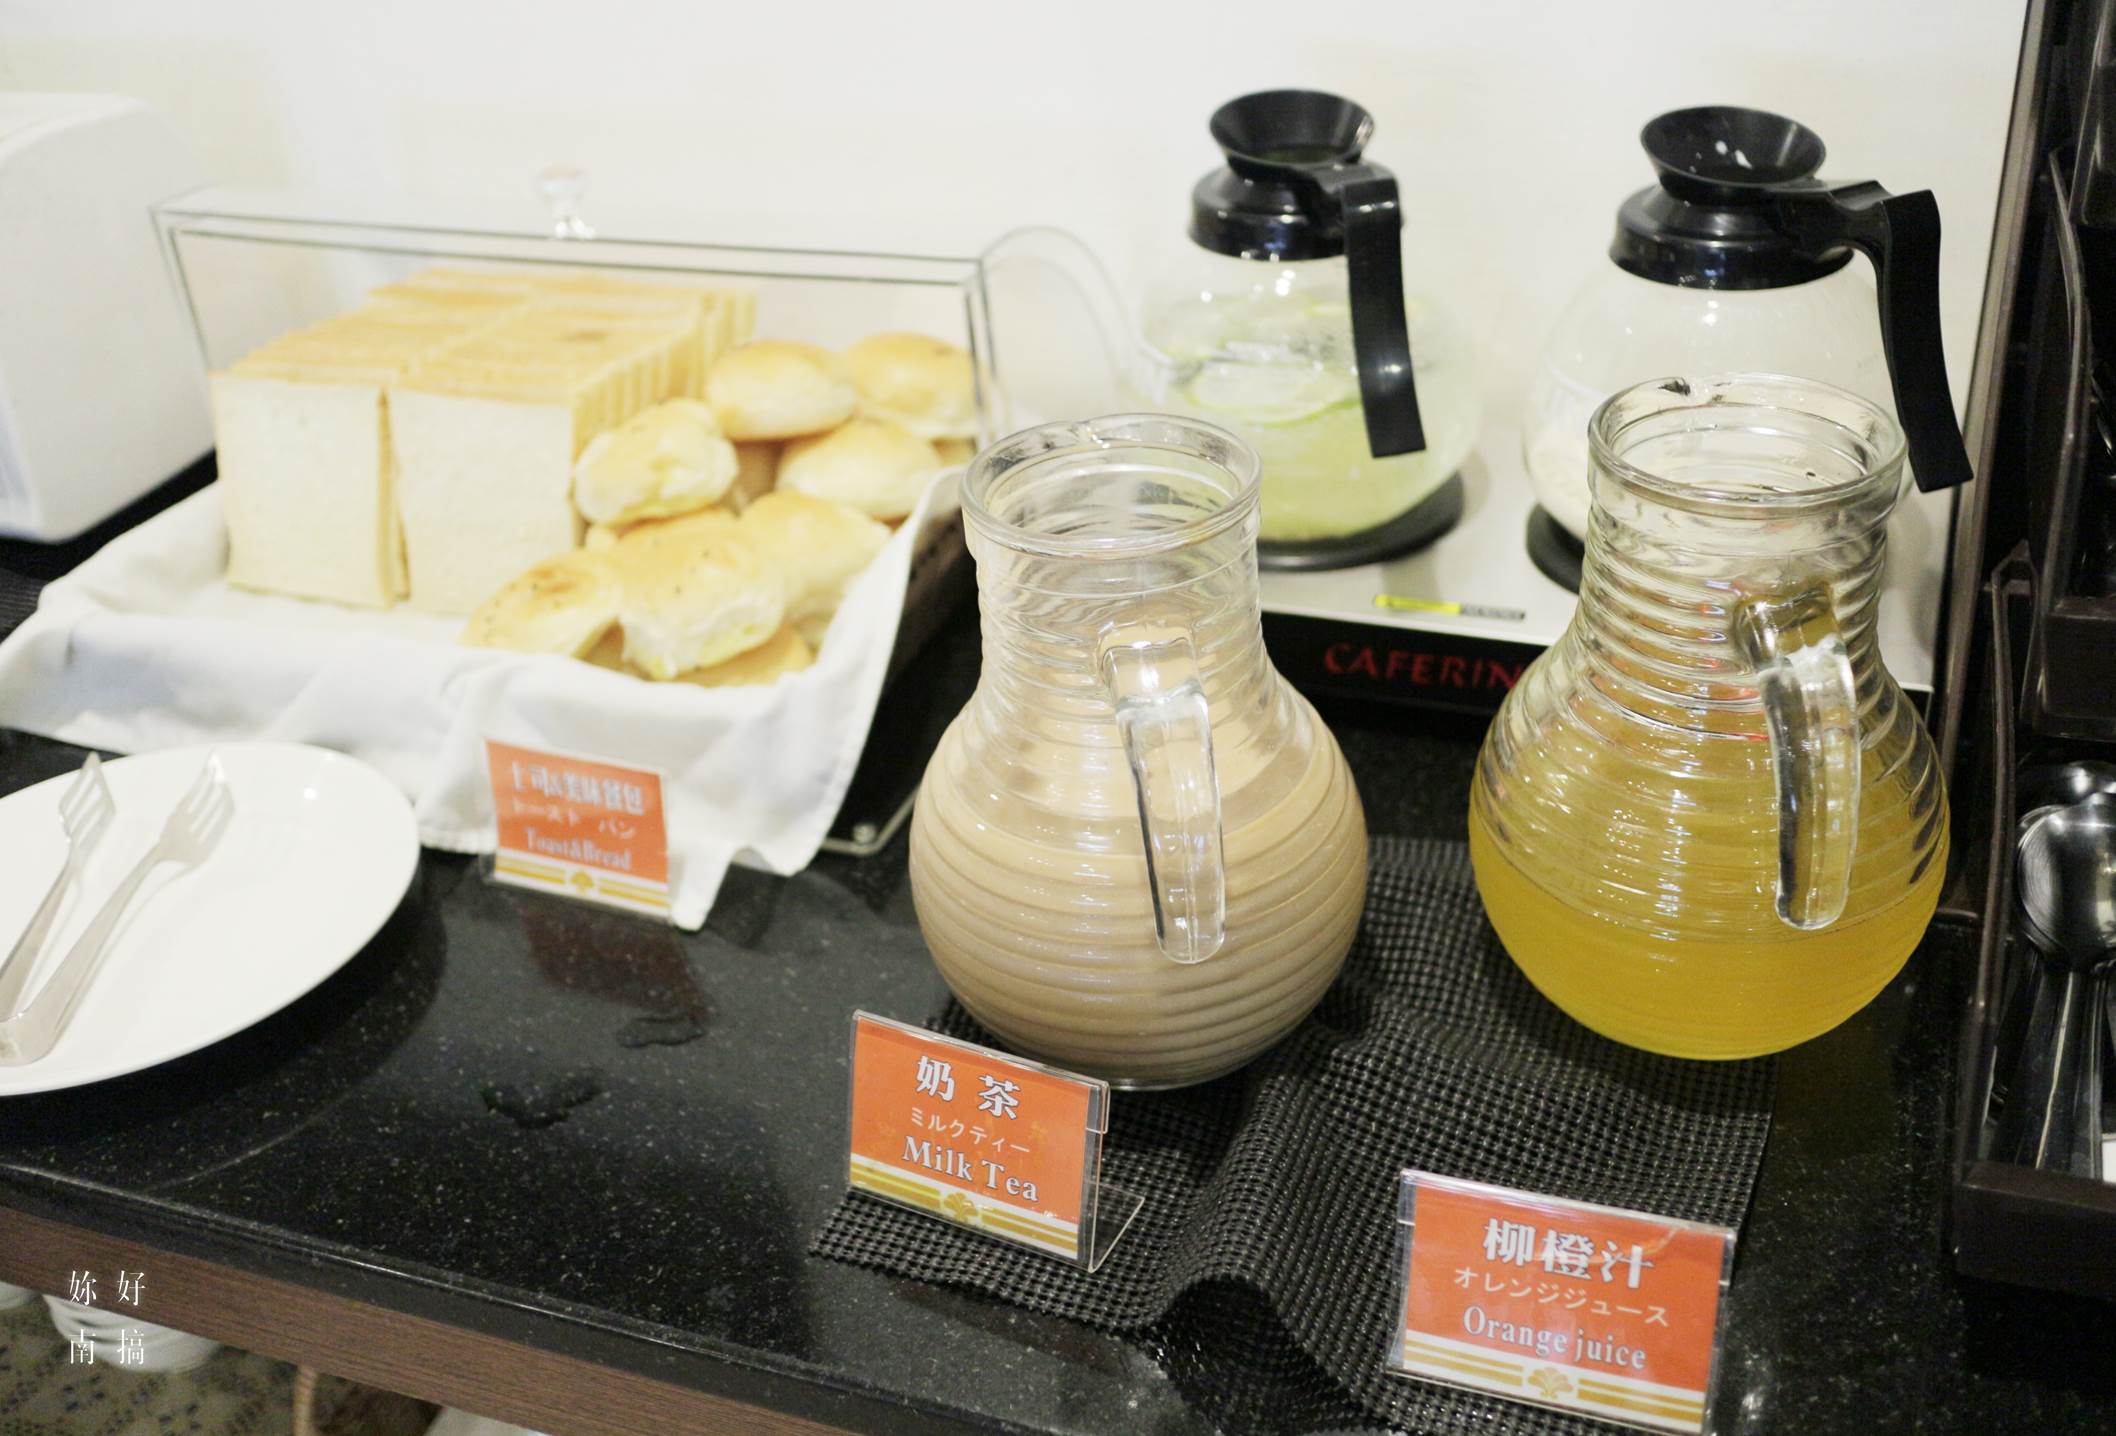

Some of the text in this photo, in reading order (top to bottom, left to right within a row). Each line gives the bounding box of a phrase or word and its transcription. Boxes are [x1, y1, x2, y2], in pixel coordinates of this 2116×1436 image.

[512, 797, 636, 840] トースト パン
[916, 1055, 1021, 1120] 奶茶
[911, 1107, 1030, 1153] ミルクティー
[902, 1135, 1039, 1202] Milk Tea
[1483, 1218, 1655, 1289] 柳橙汁
[1454, 1267, 1669, 1328] オレンジジュース
[1462, 1305, 1648, 1370] Orange juice
